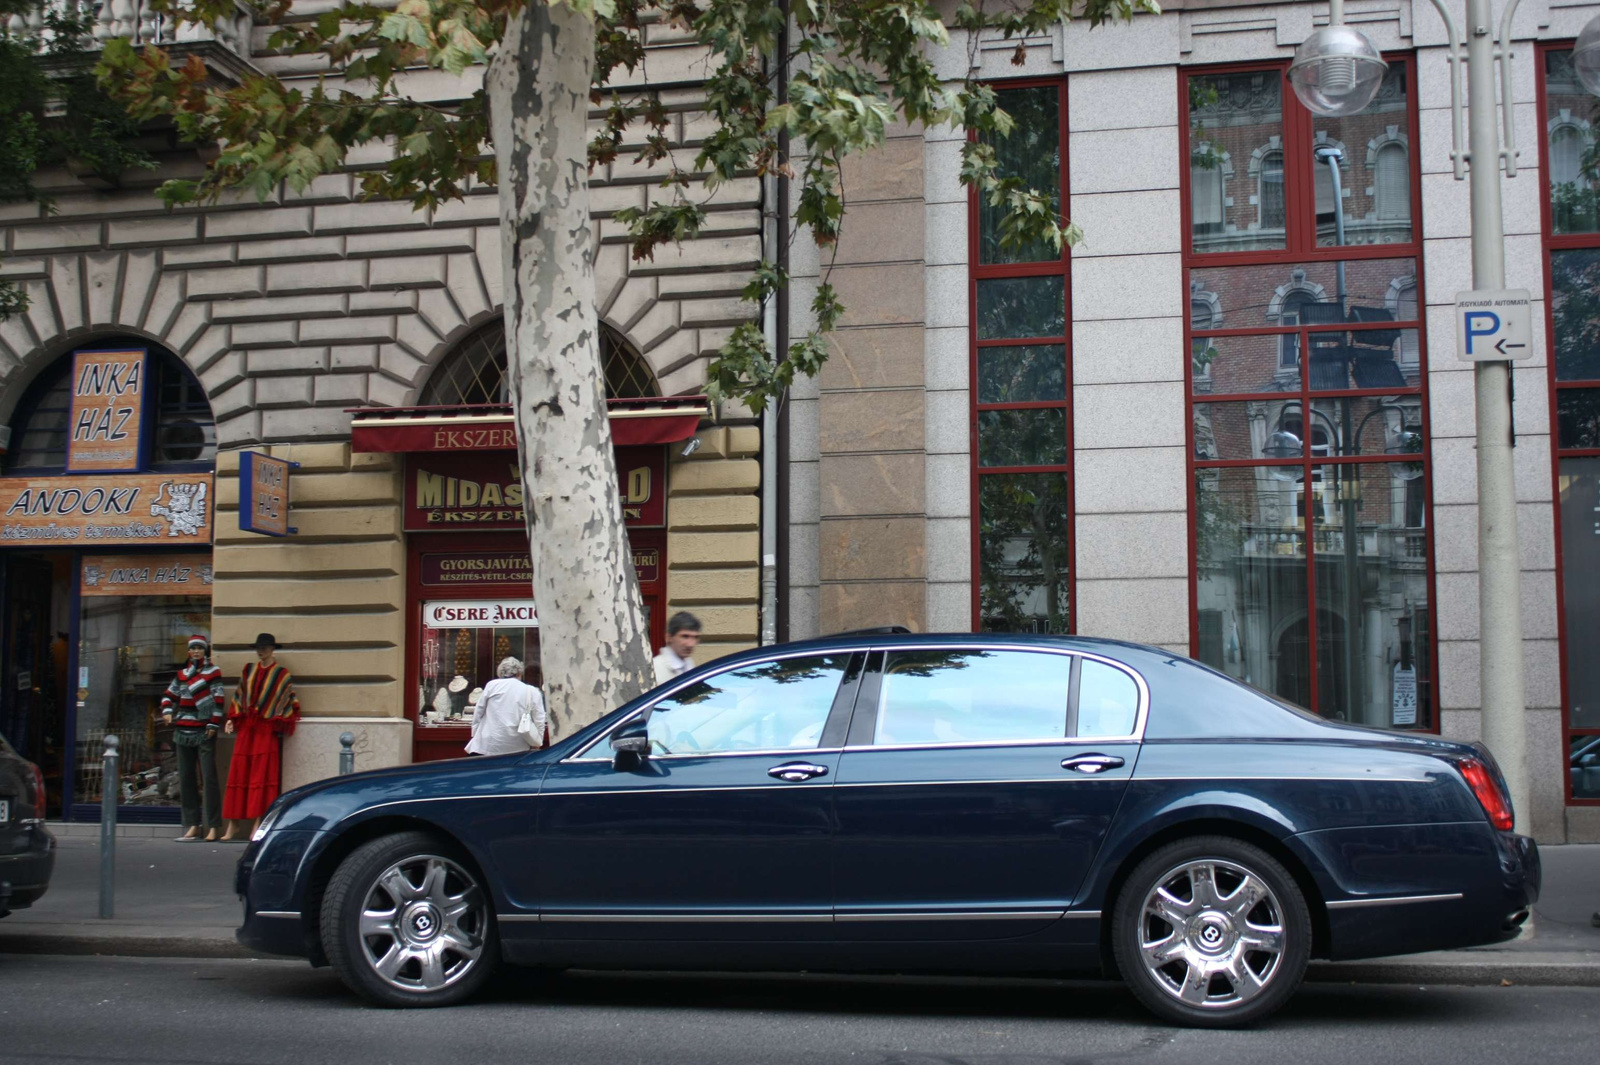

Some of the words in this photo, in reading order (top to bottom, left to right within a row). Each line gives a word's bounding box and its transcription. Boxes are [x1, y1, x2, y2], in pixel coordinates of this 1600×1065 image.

[1458, 299, 1492, 307] JEGYKIADÓ
[1464, 311, 1500, 354] P
[76, 360, 141, 396] INKA
[73, 396, 134, 441] HÁZ
[433, 427, 516, 448] ÉKSZER
[257, 461, 283, 489] INKA
[416, 468, 523, 508] MIDAS
[6, 487, 141, 516] ANDOKI
[257, 486, 280, 519] HÁZ
[84, 521, 163, 538] termékek
[440, 555, 532, 570] GYORSJAVÍTÁ
[632, 551, 657, 567] ŰRŰ
[108, 568, 149, 583] INKA
[153, 563, 192, 583] HÁZ
[440, 571, 533, 581] KÉSZÍTÉS-VÉTEL-CSER
[433, 606, 489, 622] CSERE
